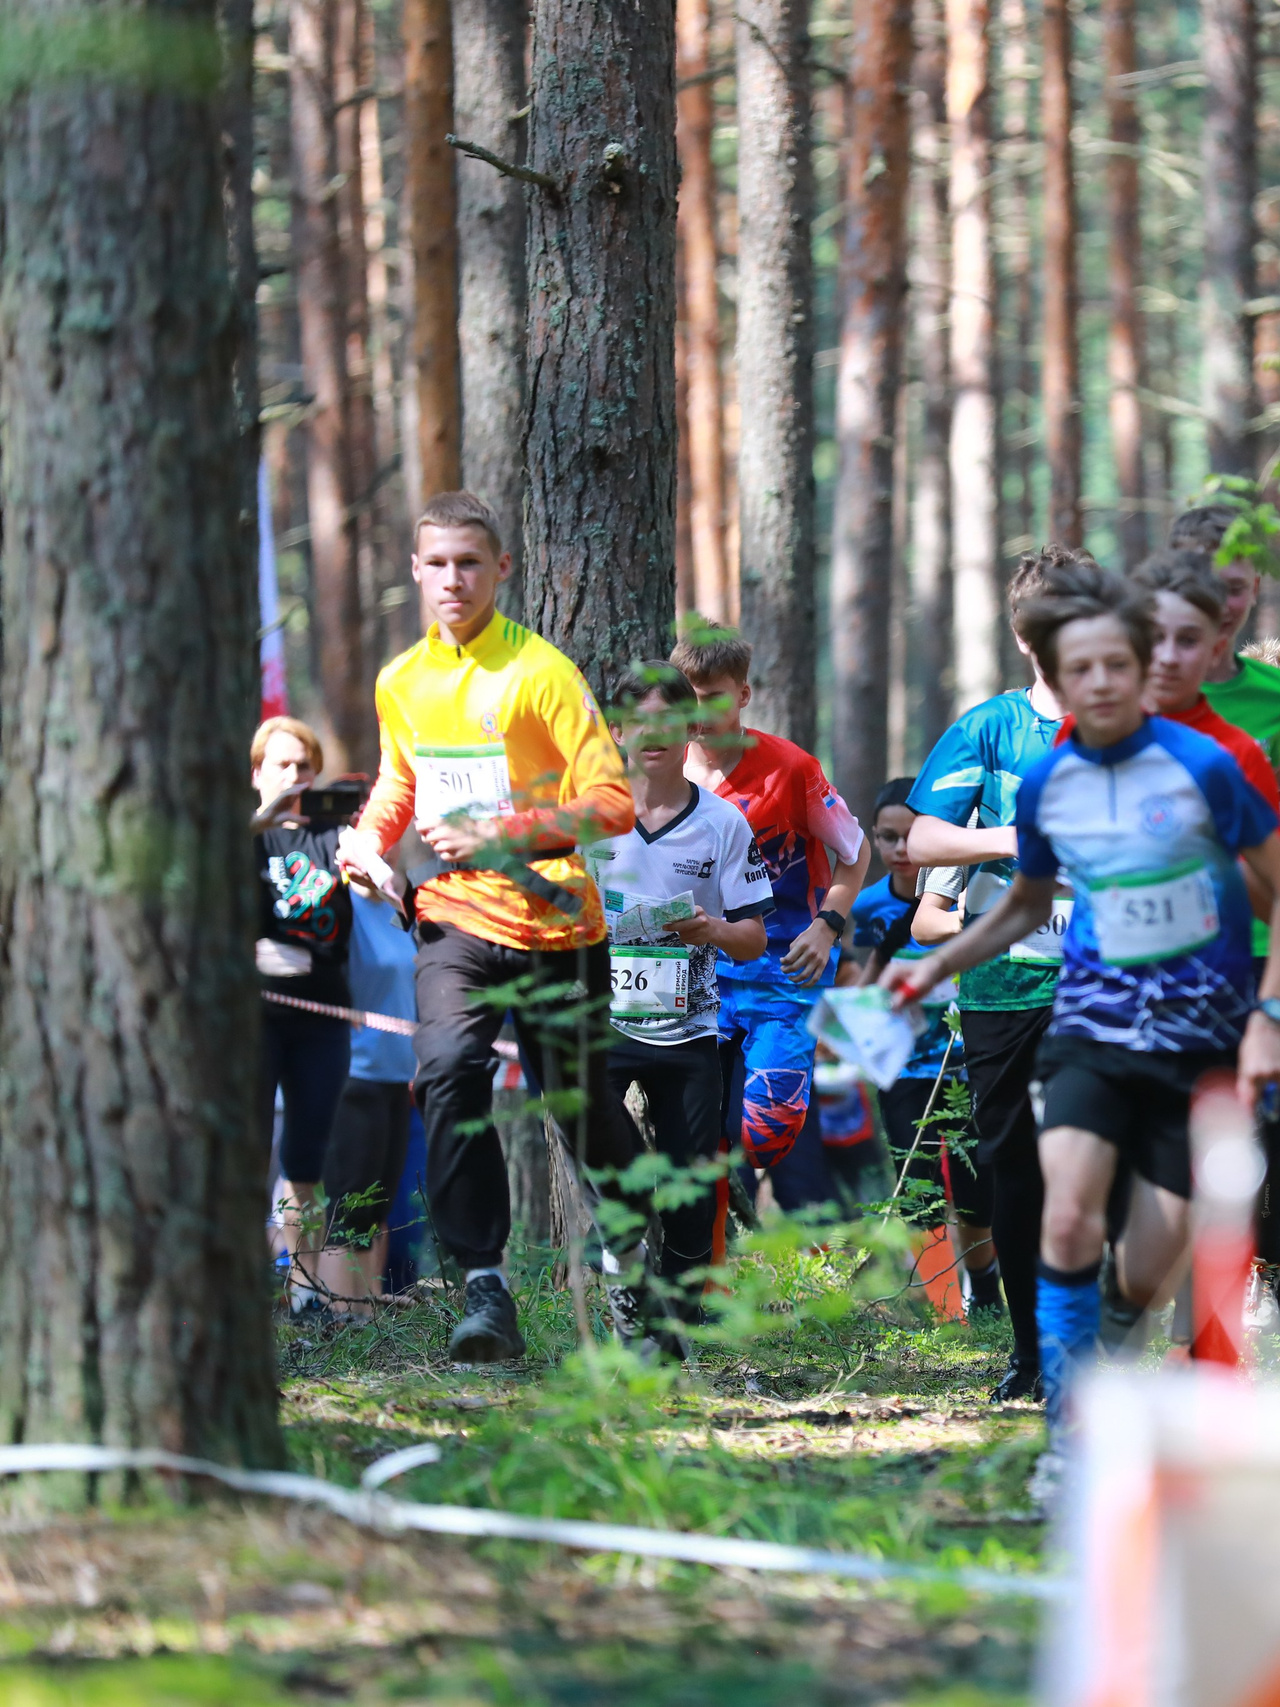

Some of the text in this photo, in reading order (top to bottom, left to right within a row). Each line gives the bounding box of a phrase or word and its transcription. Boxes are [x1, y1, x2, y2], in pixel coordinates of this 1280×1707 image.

[440, 772, 473, 794] 501
[1124, 898, 1174, 927] 521
[610, 968, 648, 991] 526
